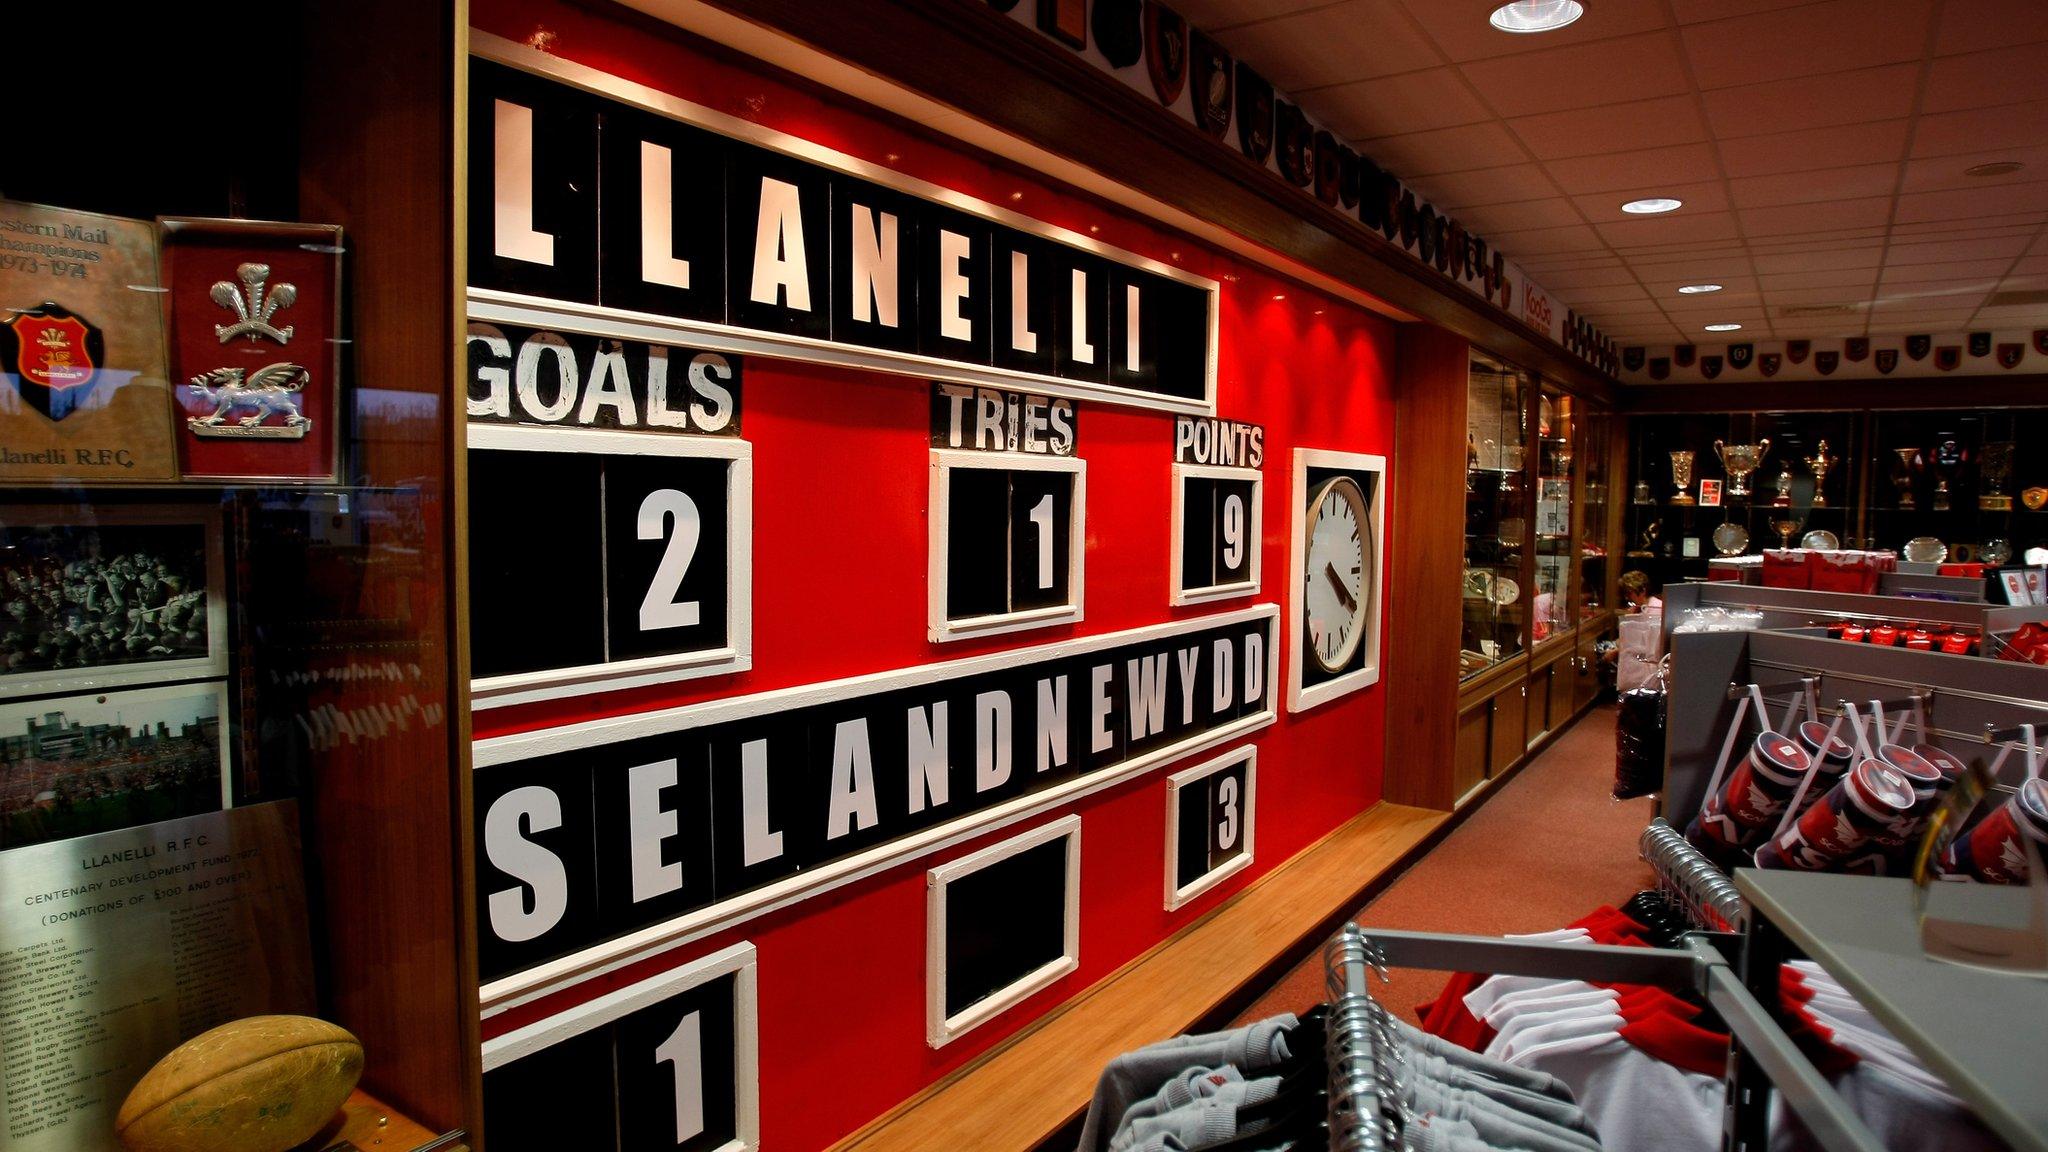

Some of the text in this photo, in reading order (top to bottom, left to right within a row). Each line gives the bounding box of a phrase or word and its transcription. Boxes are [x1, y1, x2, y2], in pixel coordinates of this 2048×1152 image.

[63, 224, 111, 246] Mail
[495, 98, 1140, 372] LLANELLI
[467, 331, 732, 432] GOALS
[938, 384, 1075, 456] TRIES
[1176, 415, 1264, 468] POINTS
[637, 488, 701, 631] 2
[1029, 494, 1054, 589] 1
[1223, 494, 1244, 570] 9
[1217, 776, 1239, 851] 3
[24, 881, 103, 907] CENTENARY
[109, 861, 198, 888] DEVELOPMENT
[202, 854, 231, 868] FUND
[82, 846, 156, 870] LLANELLI
[41, 899, 124, 927] (DONATIONS
[129, 895, 145, 907] OF
[188, 879, 211, 893] AND
[654, 1010, 704, 1145] 1
